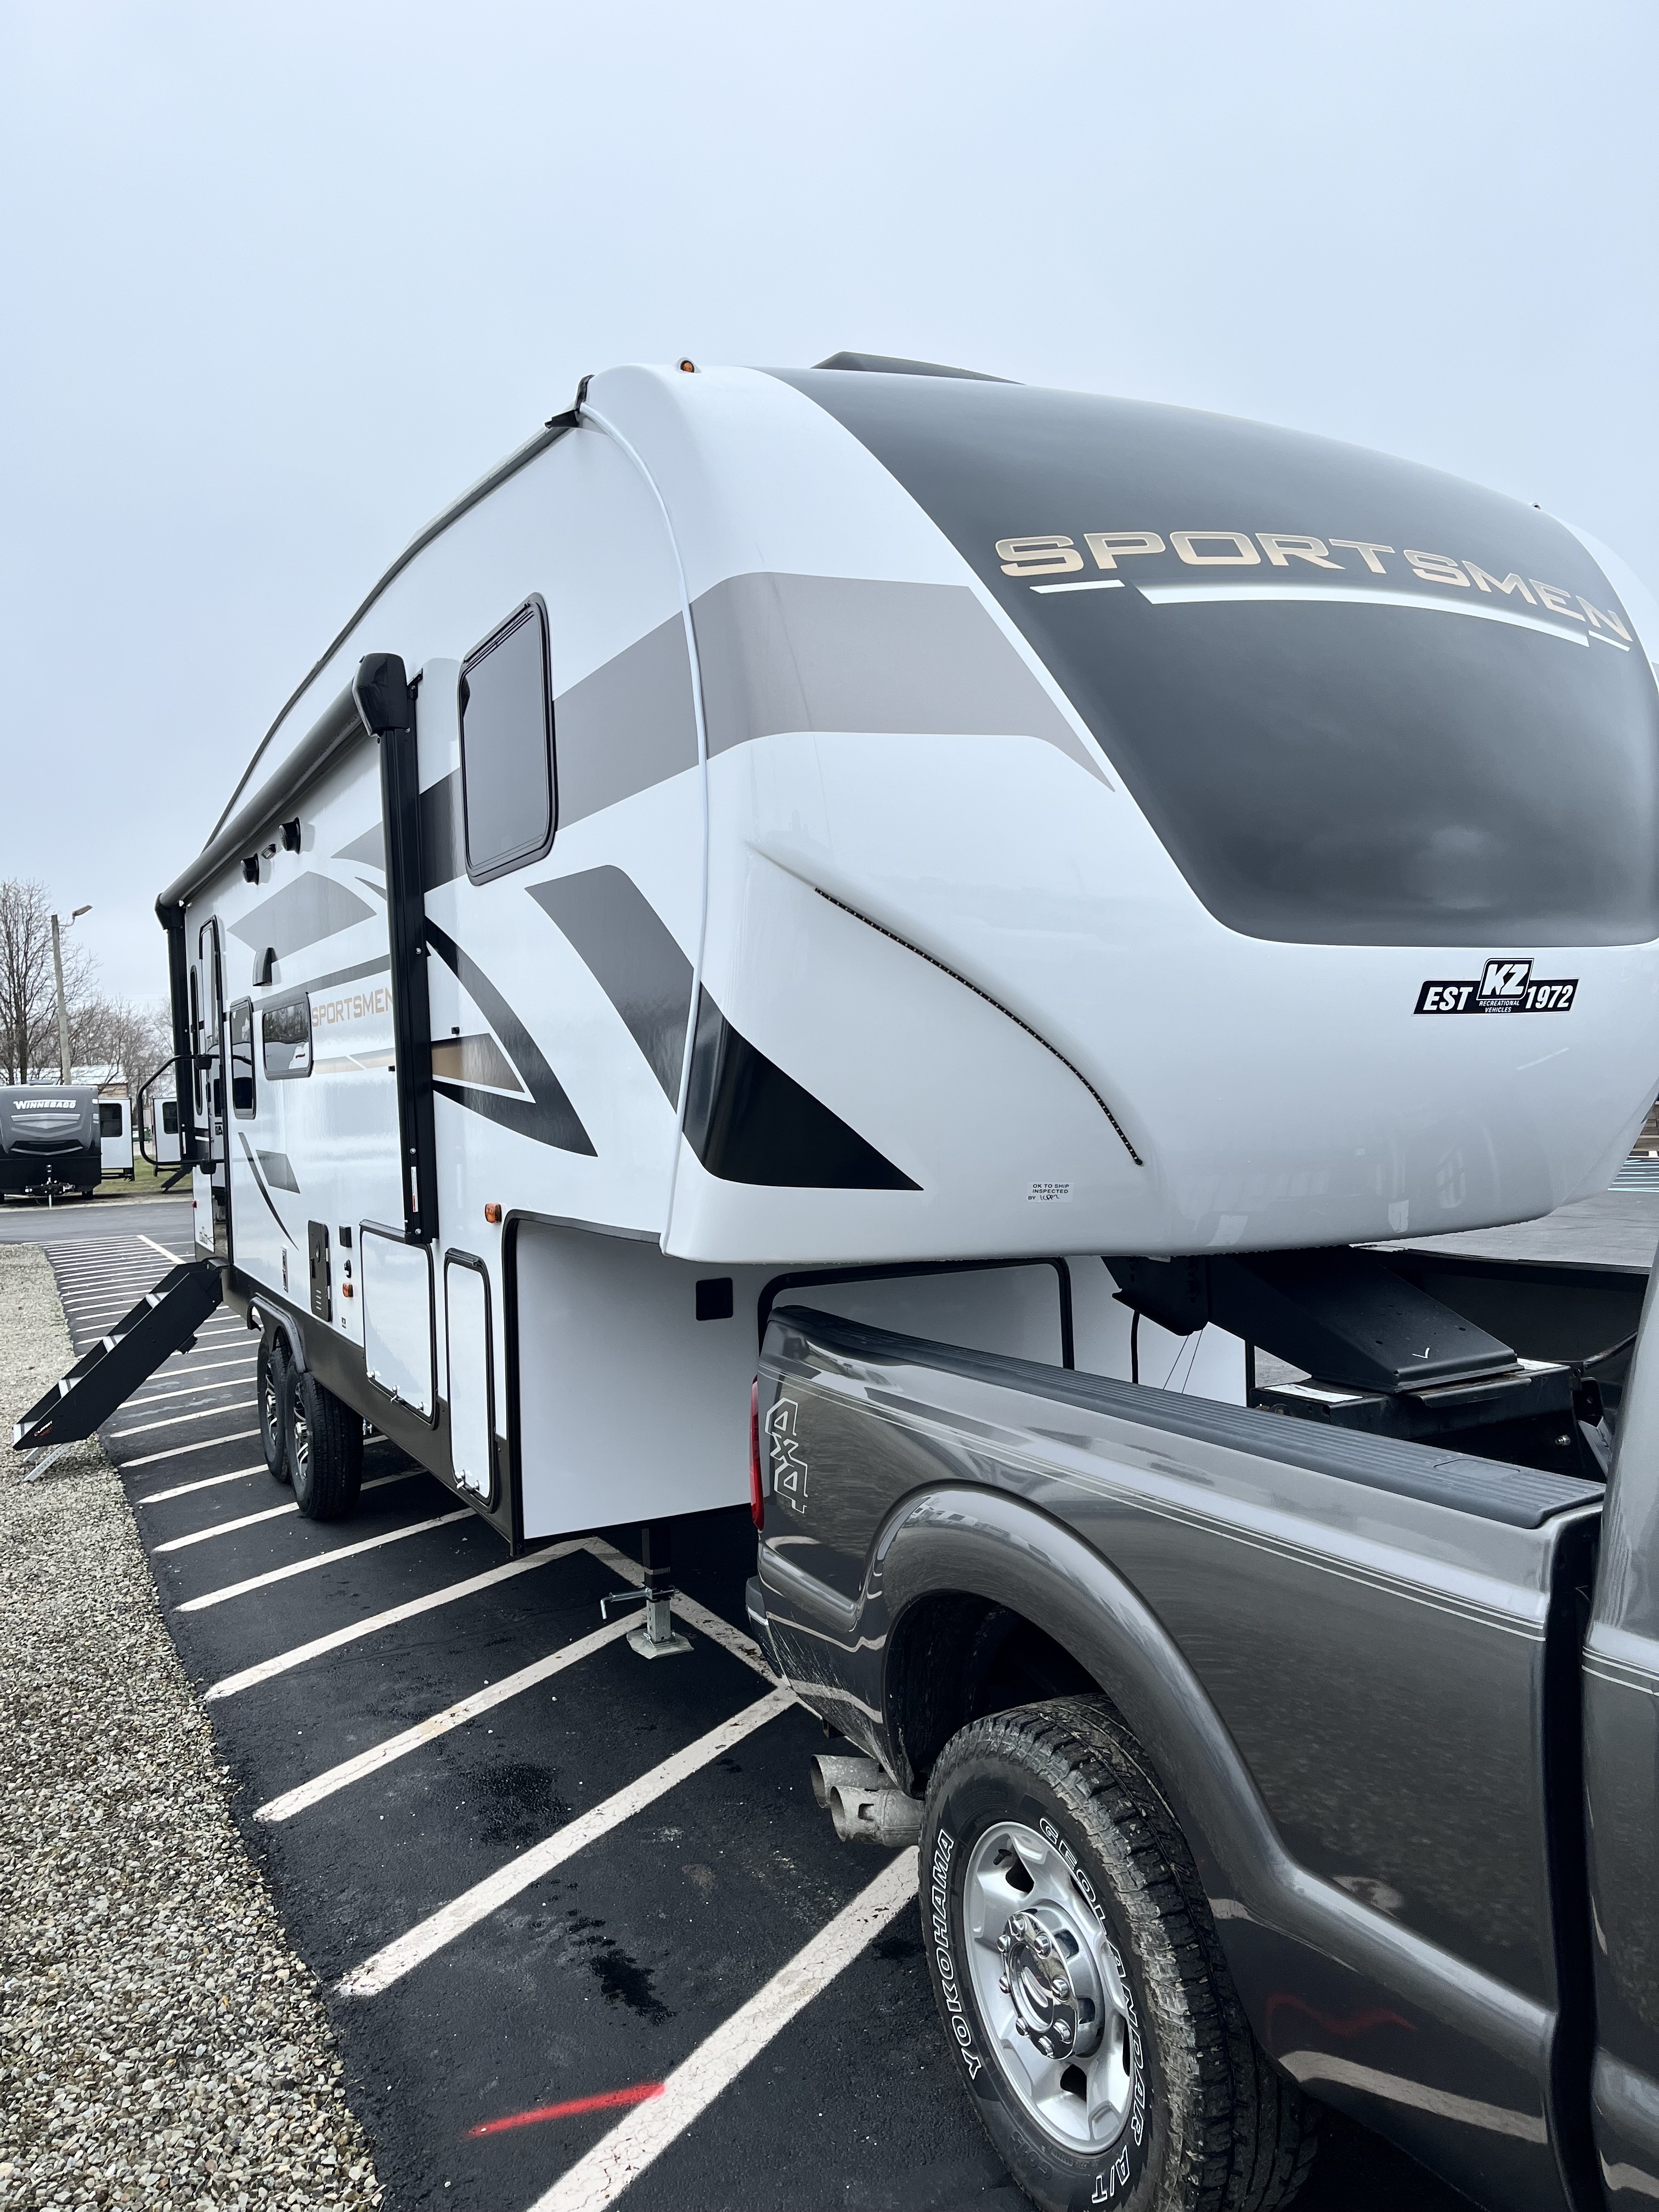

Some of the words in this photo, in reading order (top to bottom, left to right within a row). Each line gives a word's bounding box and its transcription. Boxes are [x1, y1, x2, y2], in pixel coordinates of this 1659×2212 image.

[994, 531, 1633, 642] SPORTSMEN
[1423, 986, 1474, 1011] EST
[1481, 963, 1530, 996] KZ
[1525, 985, 1573, 1009] 1972
[311, 987, 393, 1028] SPORTSMEN
[932, 1829, 982, 2080] YOKOHAMA
[1091, 2145, 1130, 2204] A/T
